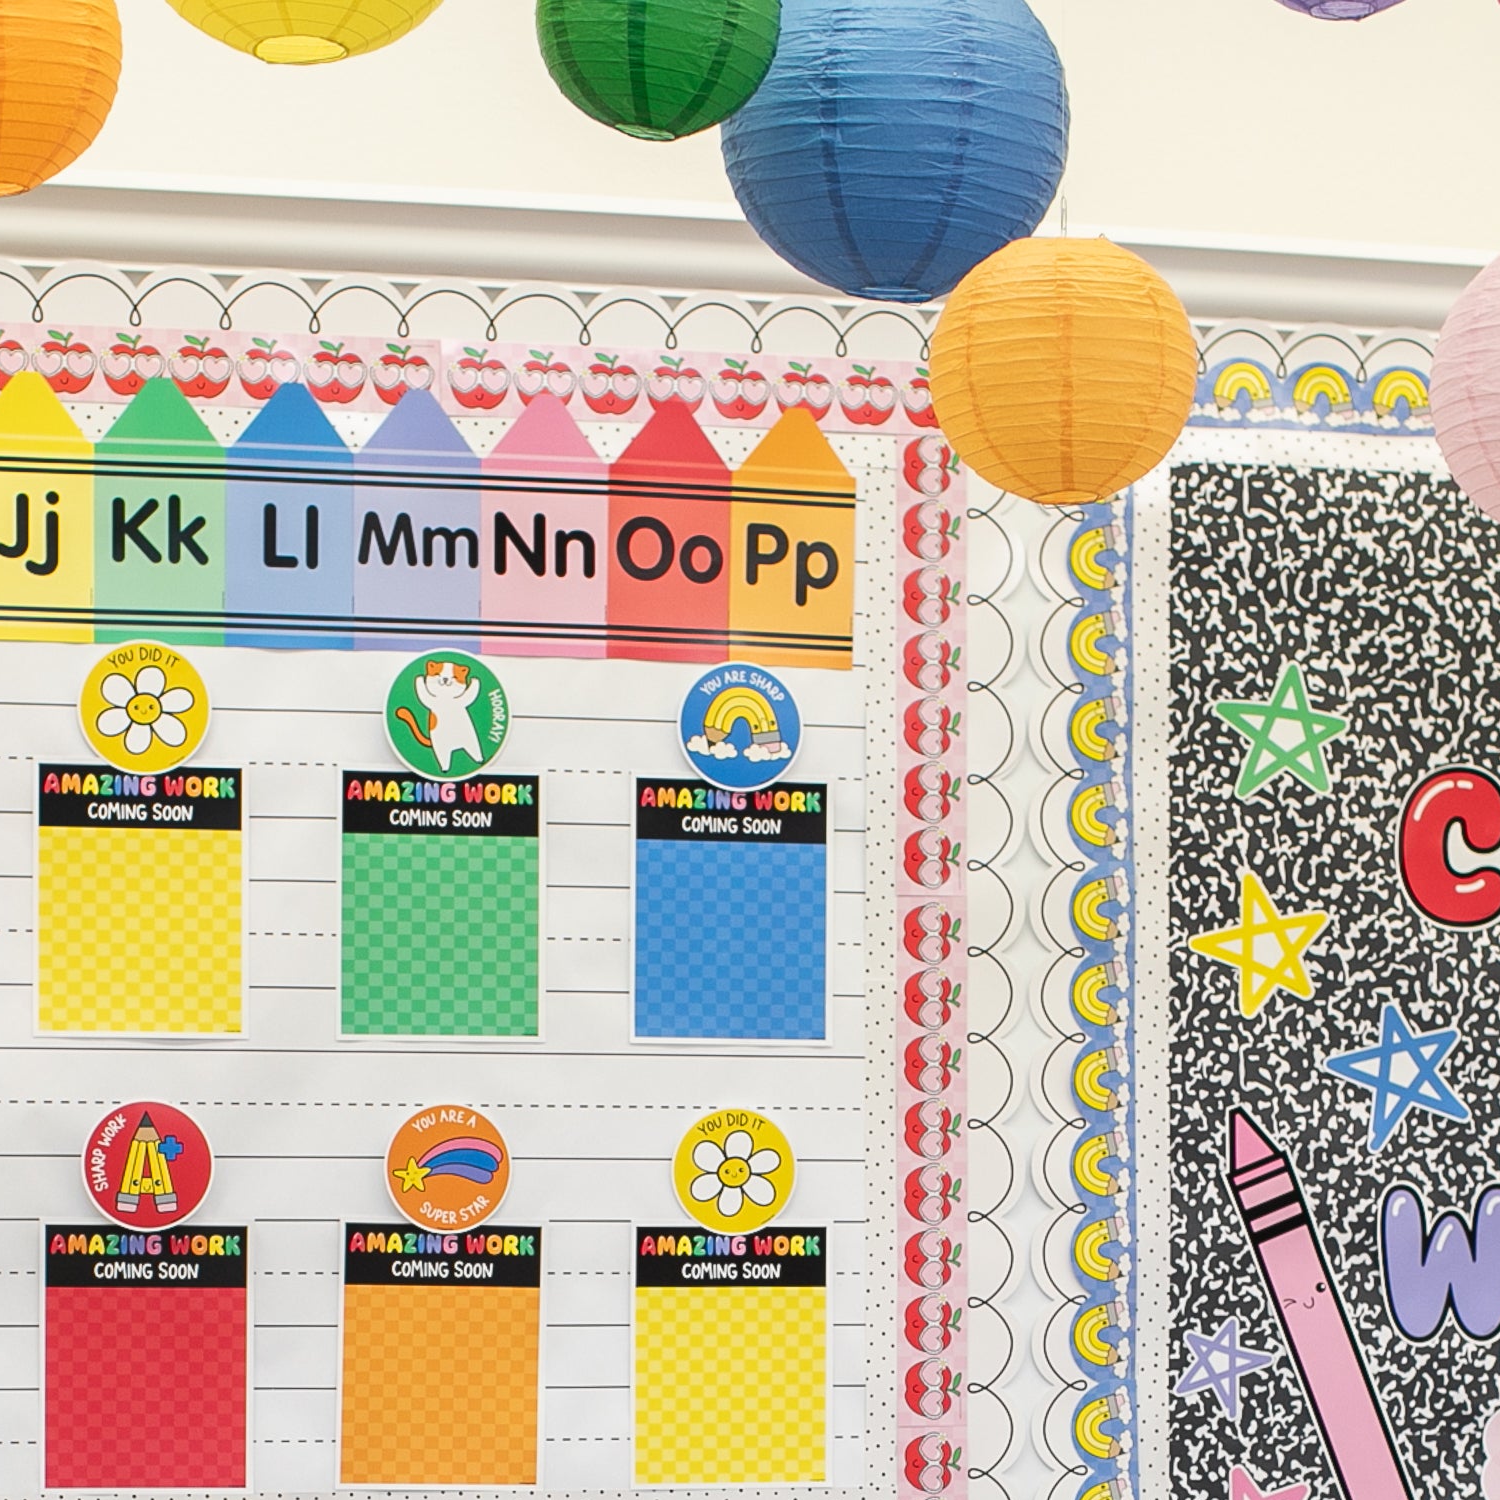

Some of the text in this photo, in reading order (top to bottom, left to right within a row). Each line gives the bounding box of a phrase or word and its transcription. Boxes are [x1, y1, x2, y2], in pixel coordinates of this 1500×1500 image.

[111, 494, 208, 566] Kk
[262, 503, 319, 569] Ll
[358, 512, 478, 569] Mm
[494, 511, 596, 579] Nn
[616, 516, 723, 584] Oo
[745, 522, 839, 606] Pp
[107, 647, 181, 670] YOU DID IT
[700, 670, 785, 702] YOU ARE SHARP
[43, 773, 236, 799] AMAZING WORK
[347, 780, 534, 806] AMAZING WORK
[87, 802, 194, 822] COMING SOON
[641, 787, 821, 813] AMAZING WORK
[389, 808, 492, 828] COMING SOON
[682, 815, 782, 835] COMING SOON
